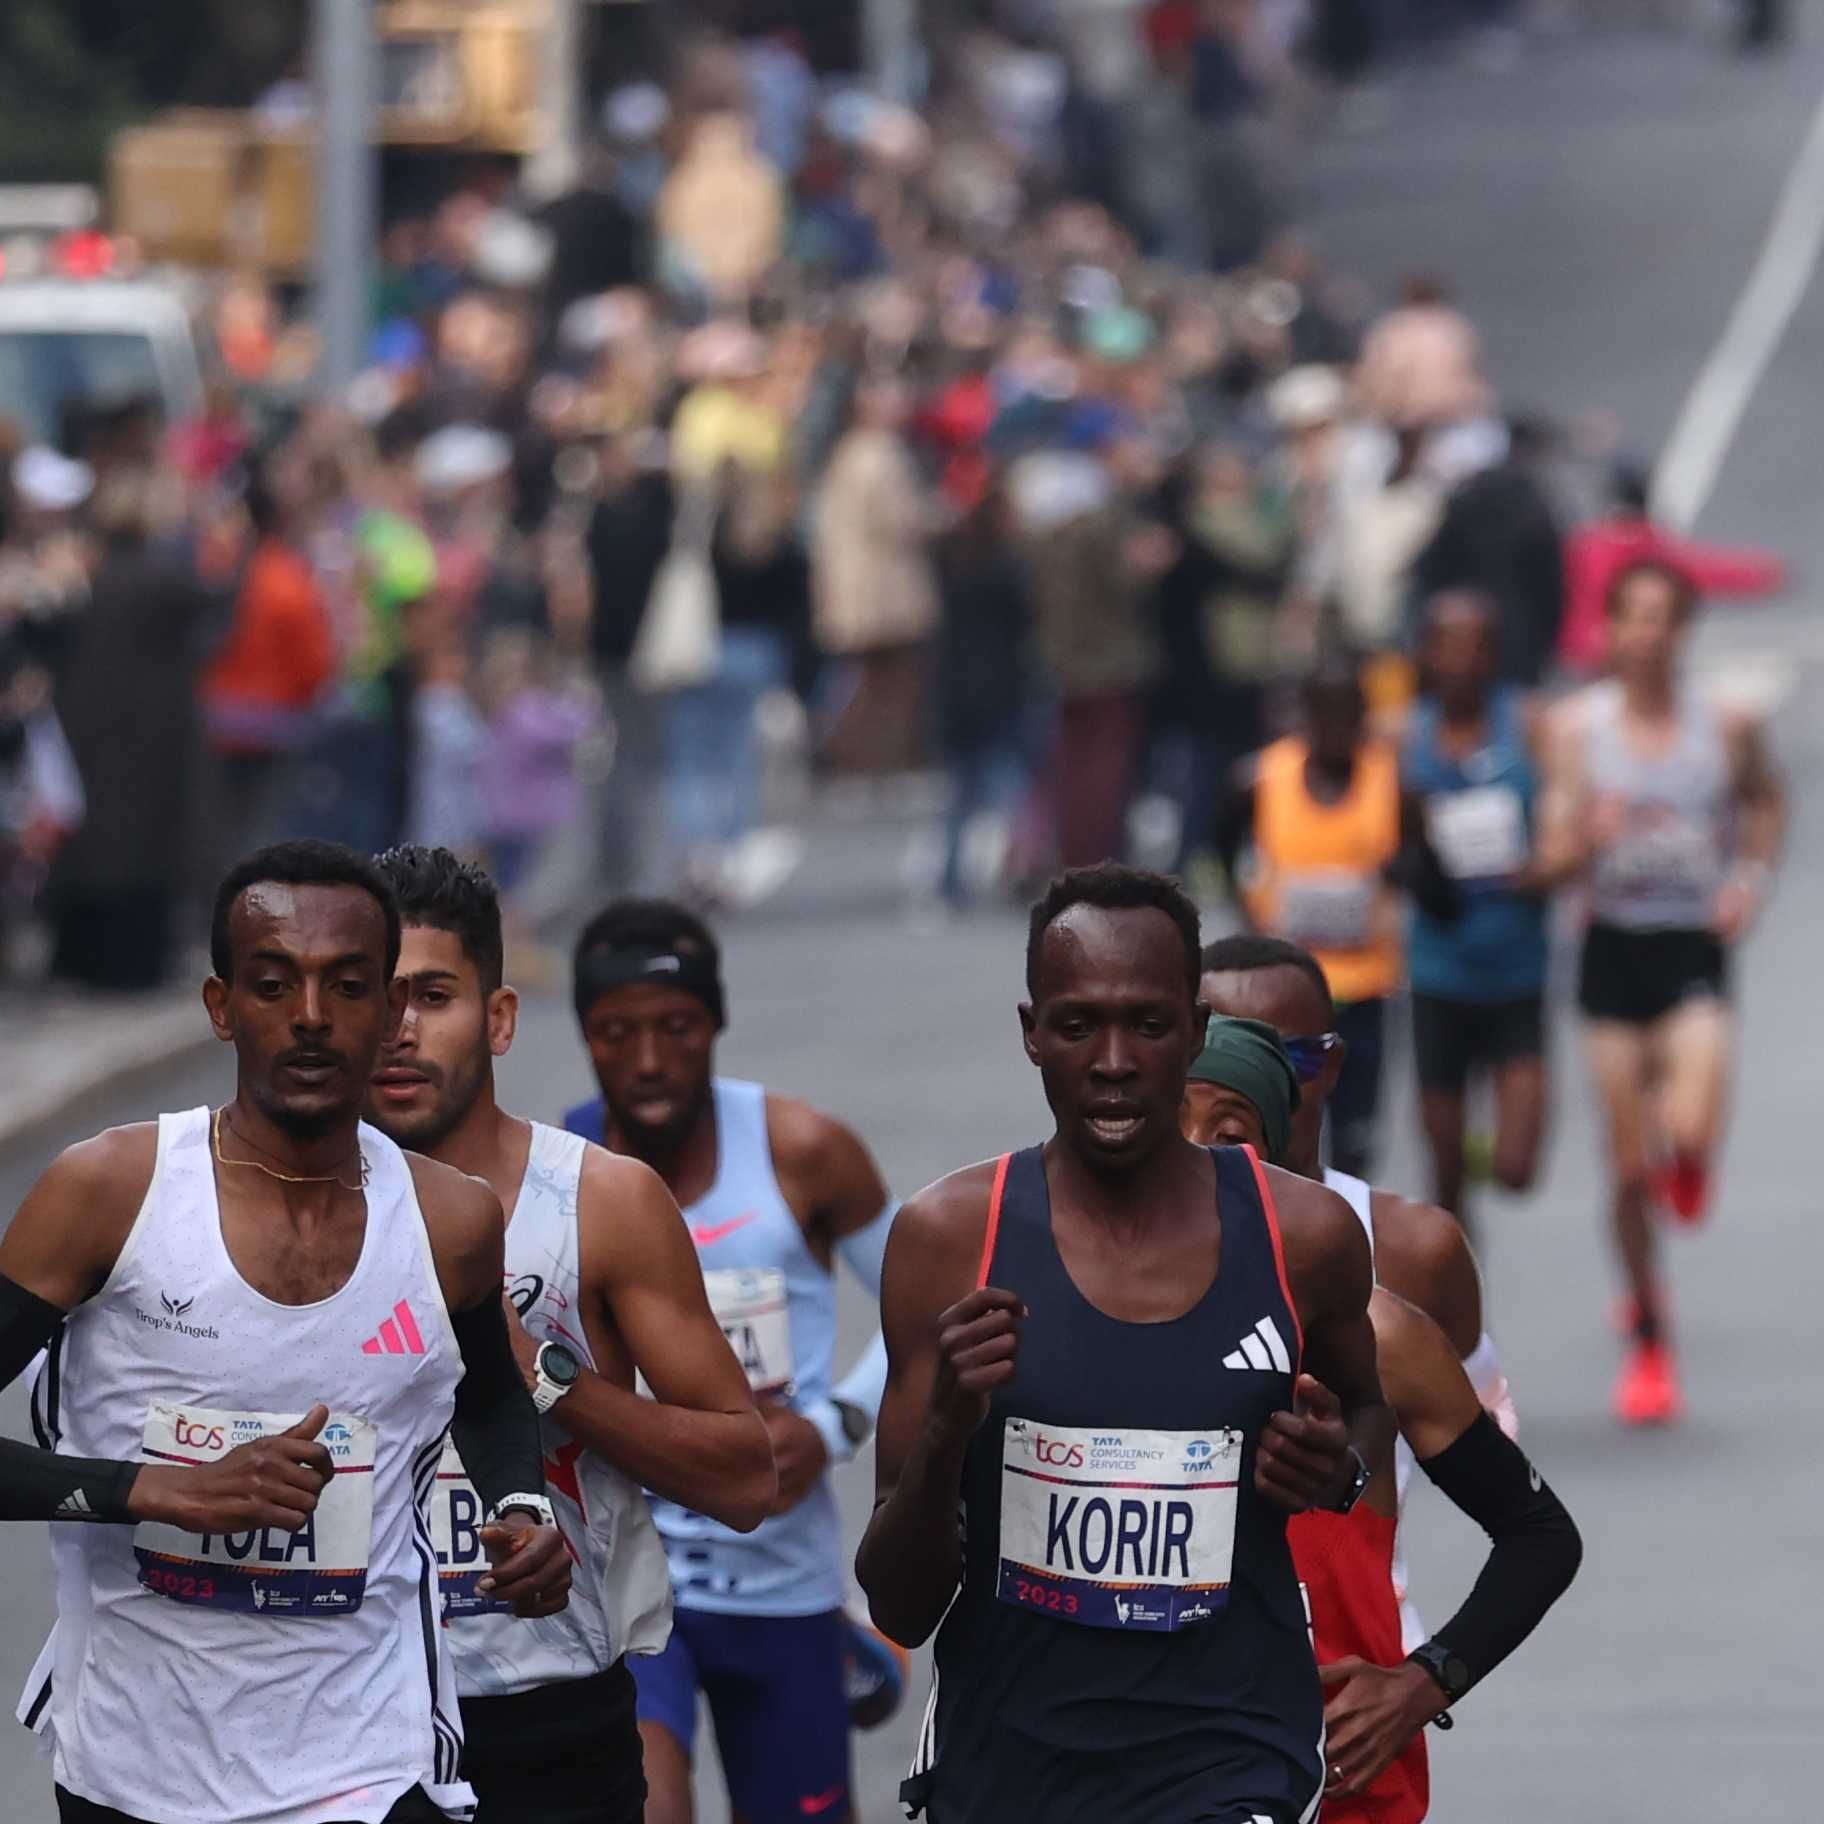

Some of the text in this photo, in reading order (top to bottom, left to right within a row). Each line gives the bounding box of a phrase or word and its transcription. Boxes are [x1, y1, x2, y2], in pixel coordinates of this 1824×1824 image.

[136, 1307, 220, 1340] Tirop's Angels
[175, 1414, 225, 1450] tcs
[232, 1420, 263, 1430] TATA
[329, 1445, 351, 1456] ATA
[1036, 1432, 1084, 1469] tcs
[1090, 1448, 1165, 1461] CONSULTANCY
[1092, 1437, 1122, 1446] TATA
[1088, 1459, 1137, 1471] SERVICES
[1182, 1460, 1213, 1472] TATA
[201, 1507, 316, 1562] LA
[1045, 1492, 1194, 1578] KORIR
[146, 1568, 215, 1598] 2023
[1015, 1580, 1079, 1615] 2023
